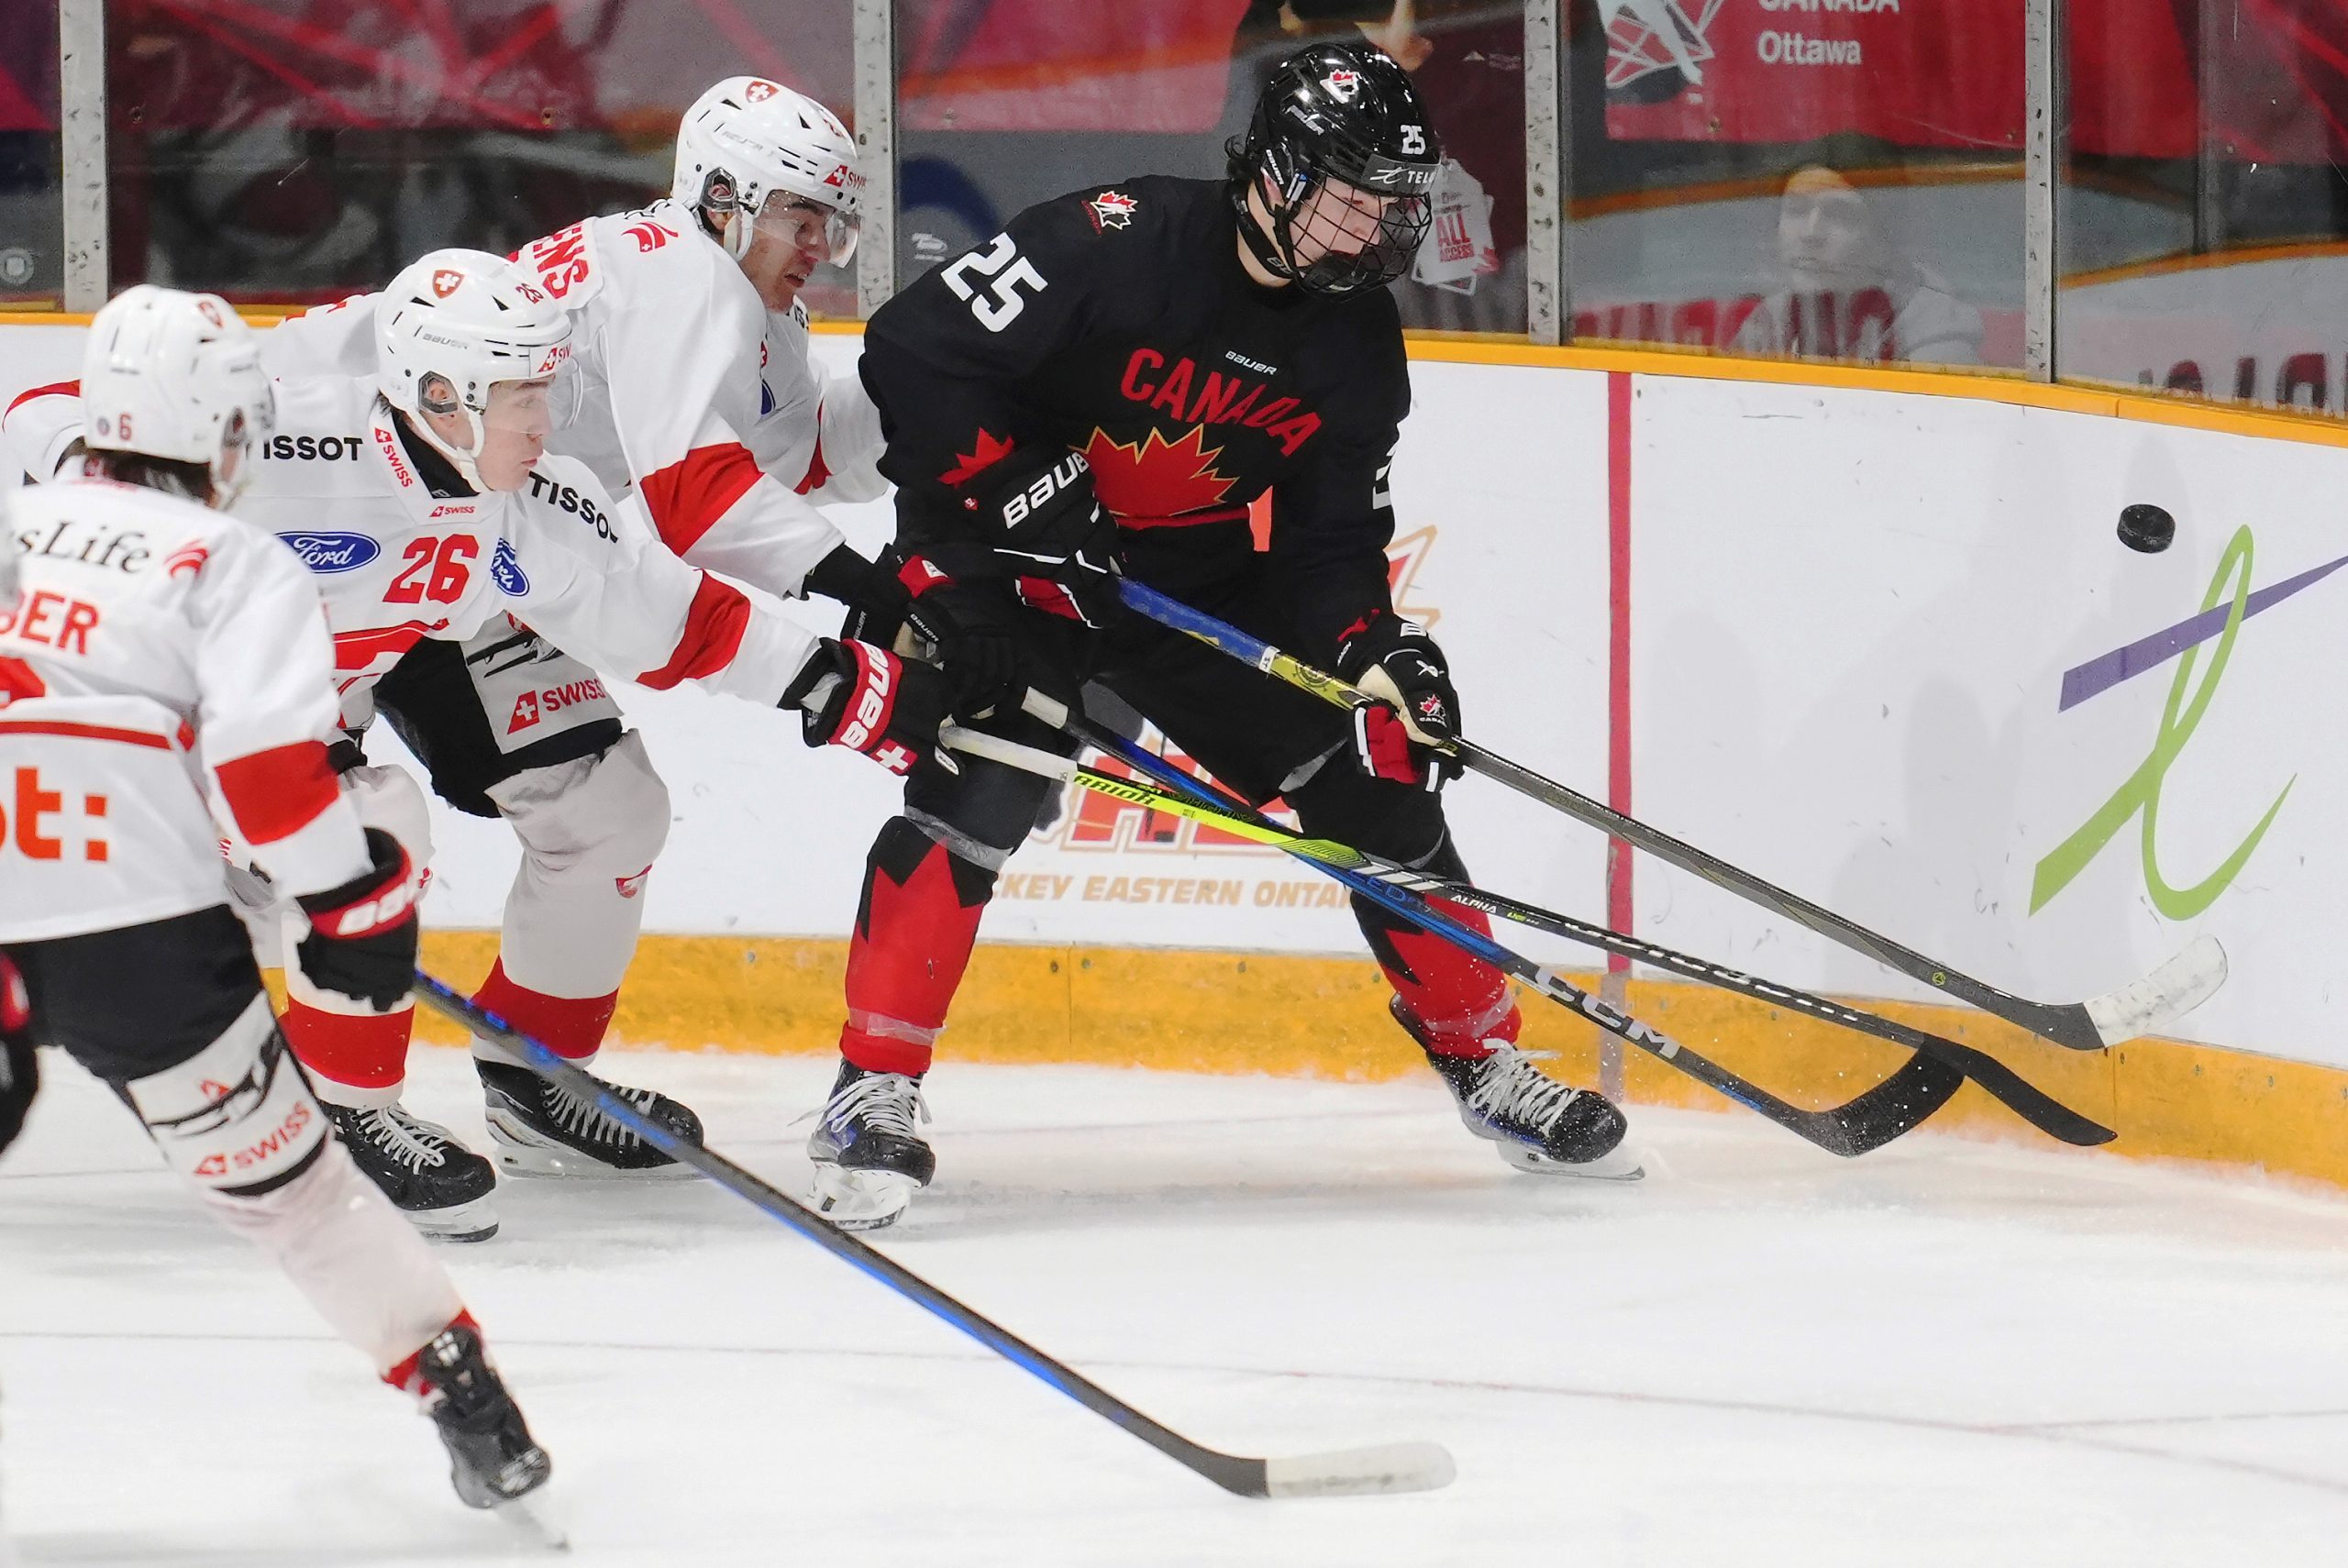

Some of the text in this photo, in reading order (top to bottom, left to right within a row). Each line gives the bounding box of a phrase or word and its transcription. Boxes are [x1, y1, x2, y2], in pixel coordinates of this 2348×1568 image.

[1757, 29, 1862, 64] Ottawa
[1400, 124, 1426, 155] 25
[1435, 211, 1471, 248] ALL
[515, 282, 544, 304] 26
[939, 231, 1049, 333] 25
[1224, 350, 1278, 376] BAUER
[1120, 347, 1323, 458] CANADA
[118, 414, 132, 441] 6
[382, 444, 414, 489] SWISS
[444, 505, 475, 516] SWISS
[527, 469, 620, 544] TISSO
[293, 537, 354, 568] Ford
[382, 533, 481, 605] 26
[910, 613, 940, 642] BAUER
[542, 678, 606, 712] SWISS
[1081, 874, 1245, 906] EASTERN
[1450, 893, 1498, 914] ALPHA
[1534, 966, 1681, 1060] CCM
[233, 1100, 311, 1169] SWISS
